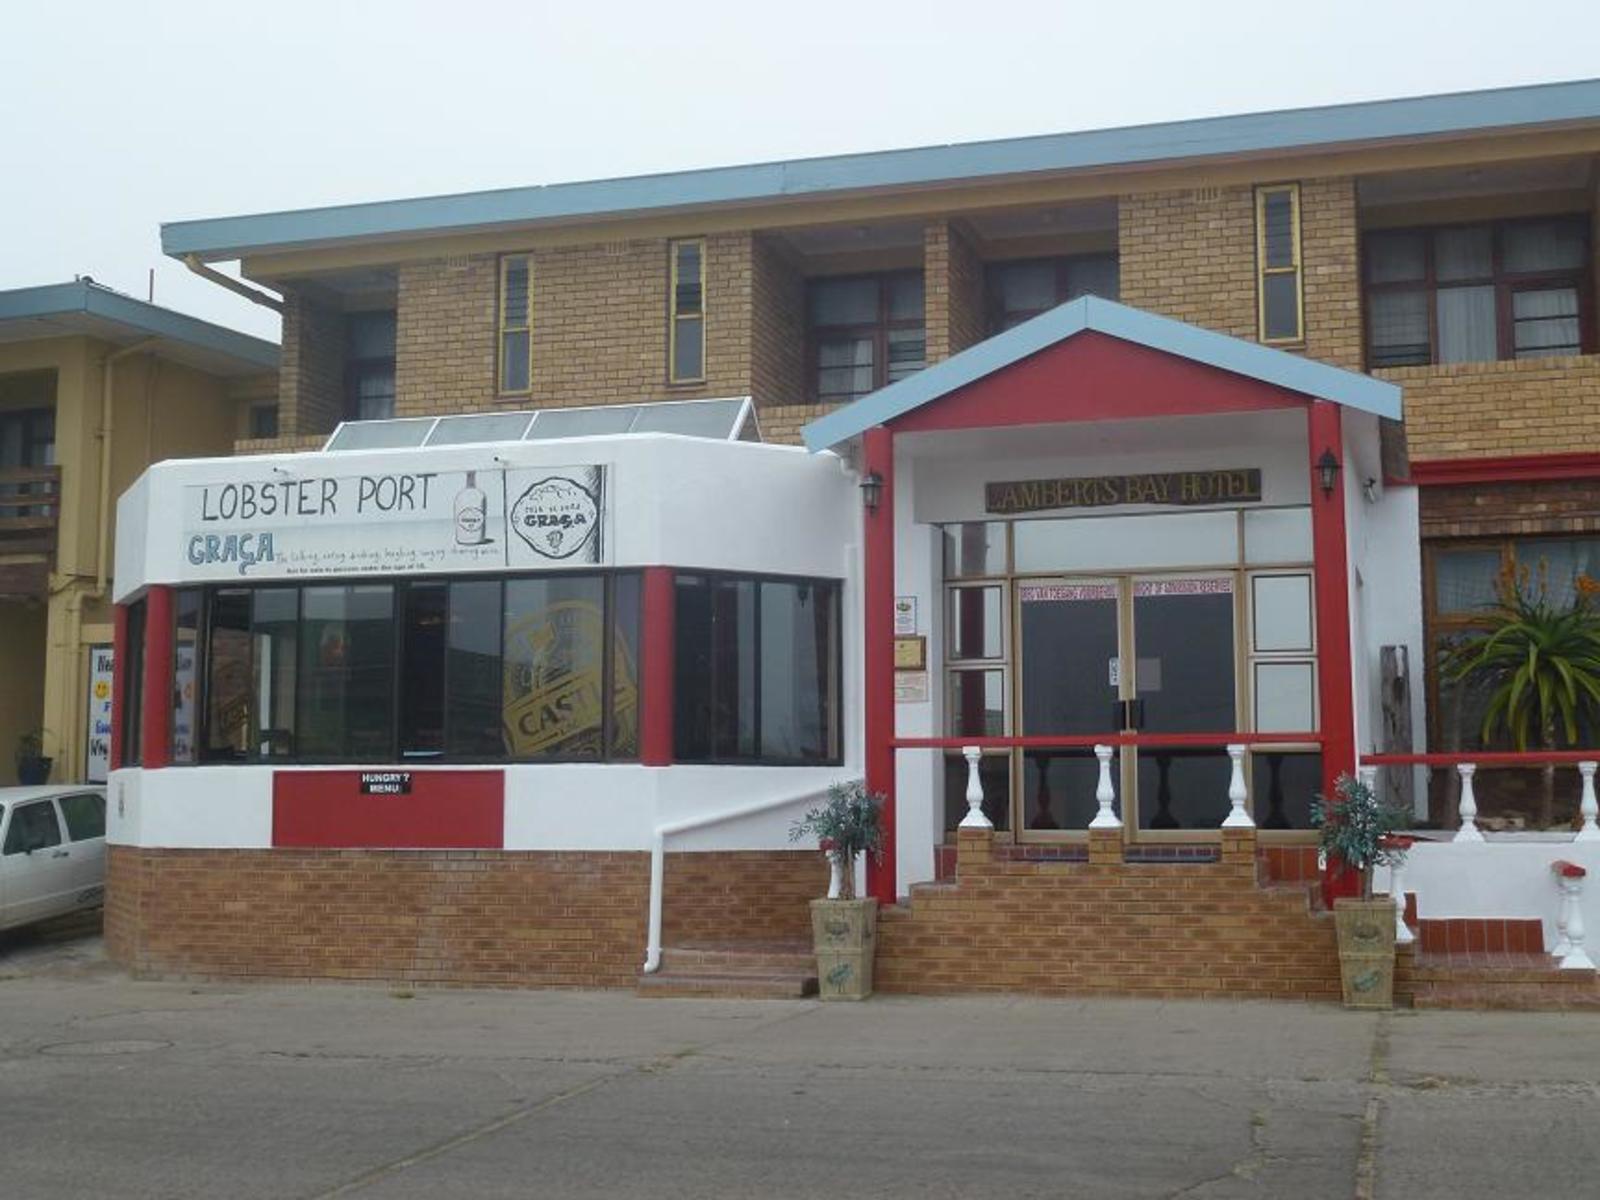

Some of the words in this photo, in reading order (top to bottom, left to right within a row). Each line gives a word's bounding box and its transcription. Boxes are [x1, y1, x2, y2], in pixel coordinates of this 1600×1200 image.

[202, 478, 338, 521] LOBSTER
[357, 473, 438, 513] PORT
[1125, 475, 1171, 503] BAY
[1180, 472, 1258, 501] HOTEL
[523, 512, 587, 529] GRAÇA
[188, 532, 274, 576] GRAÇA
[361, 773, 401, 782] HUNGRY
[369, 784, 399, 793] MENU
